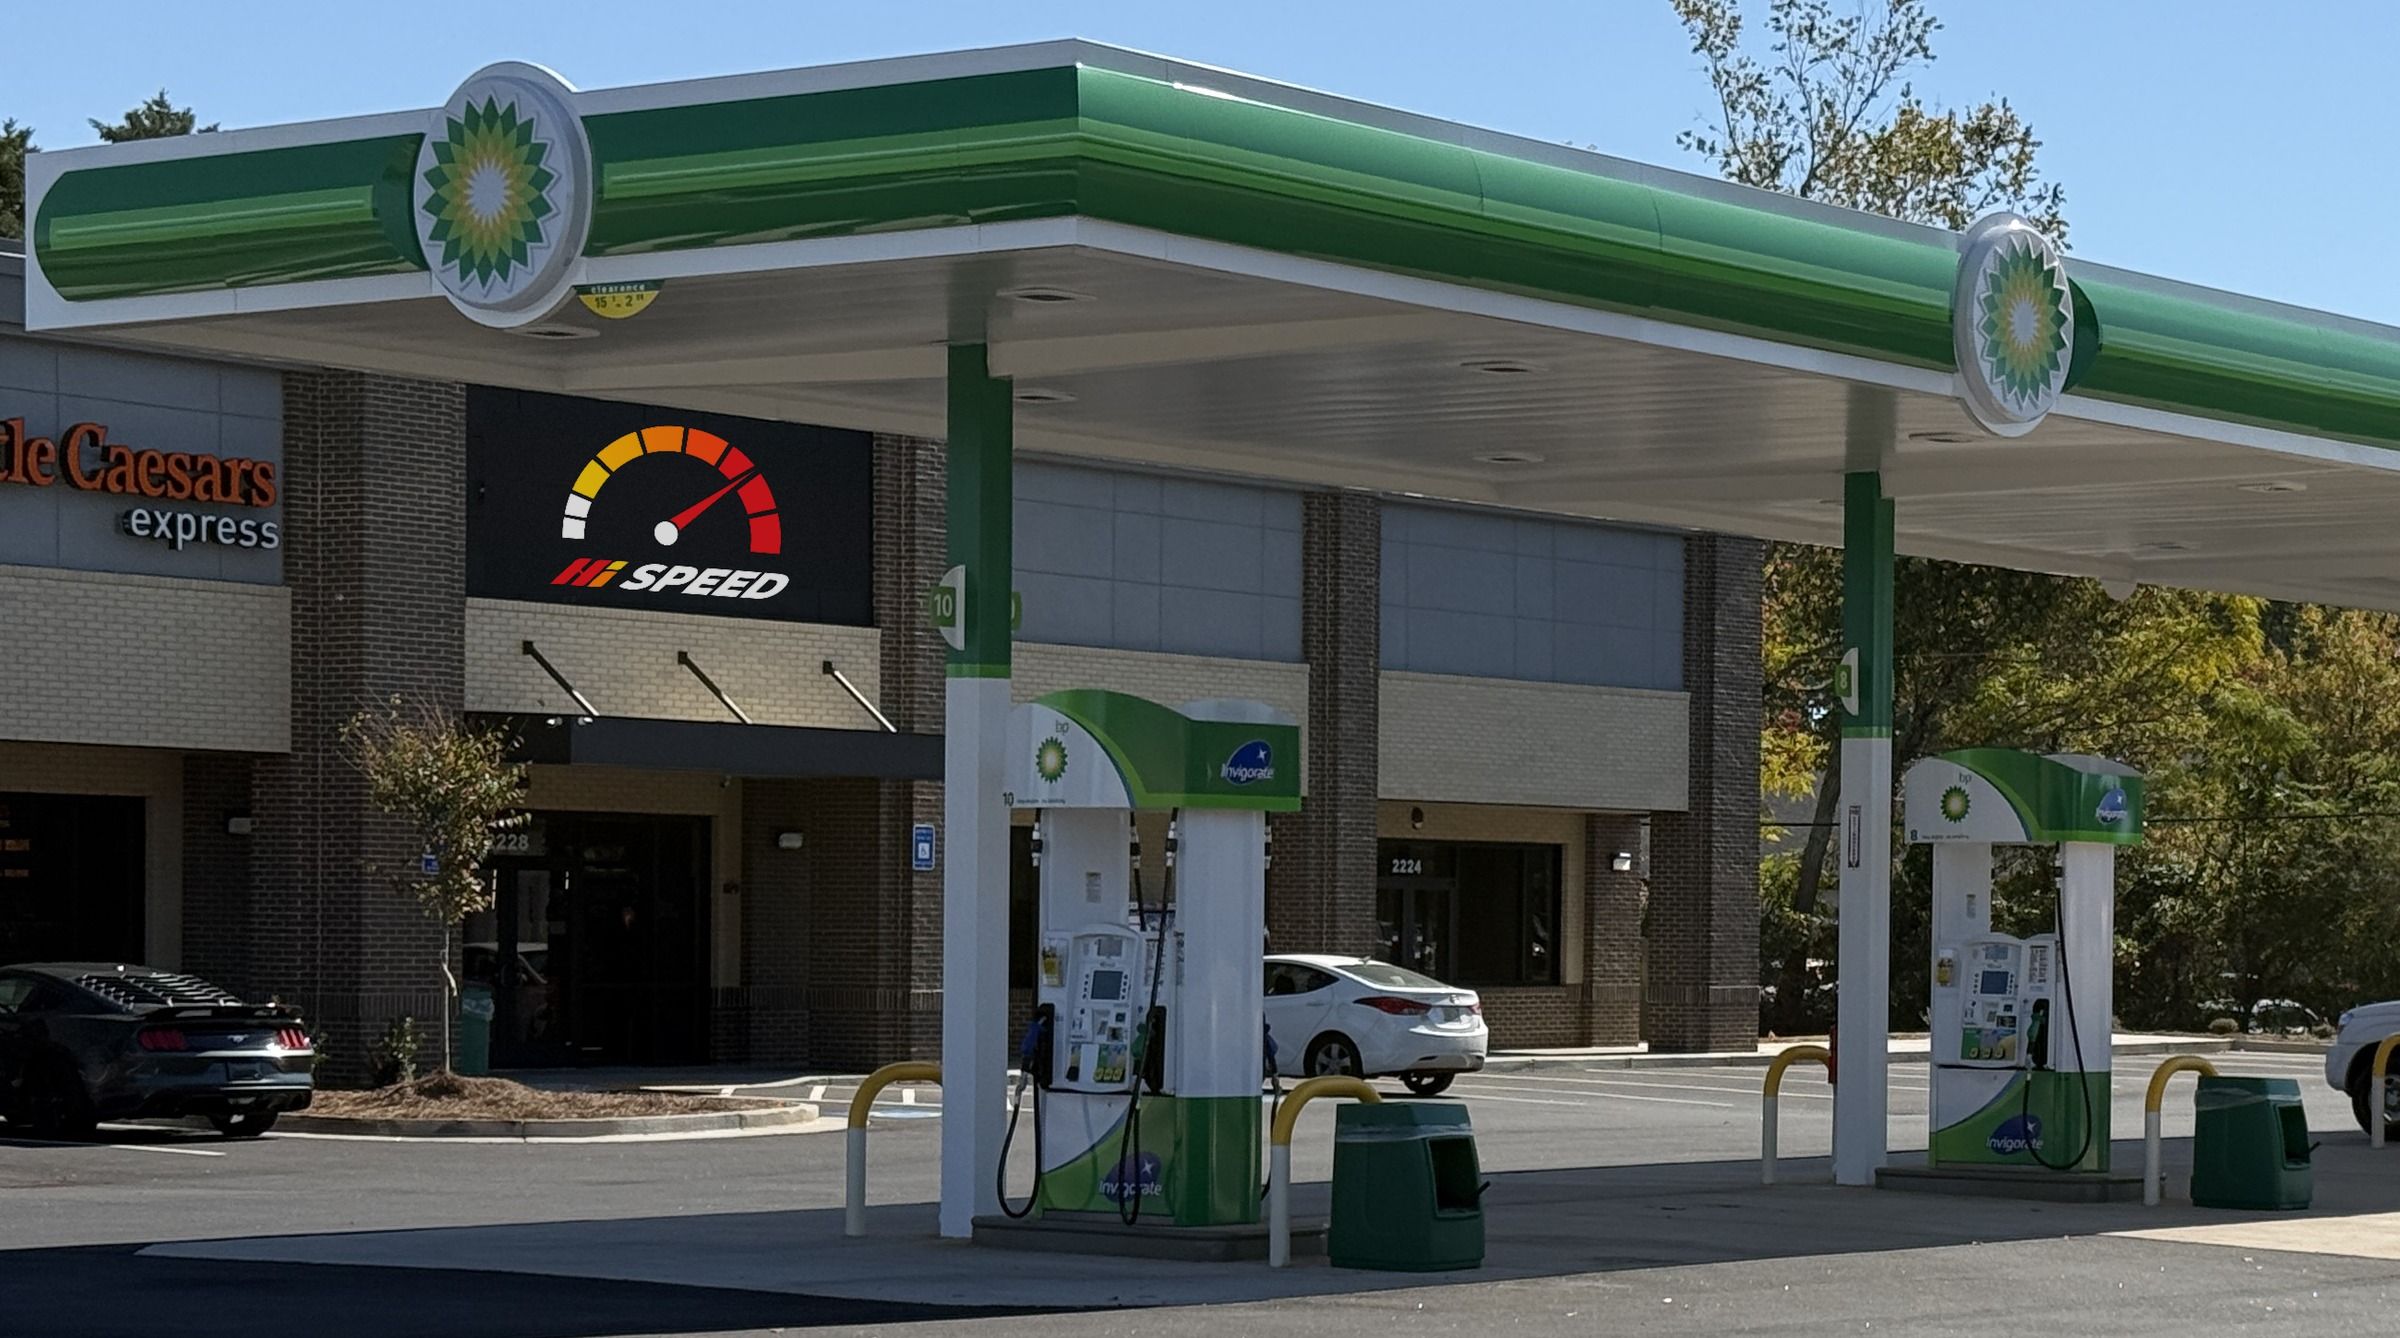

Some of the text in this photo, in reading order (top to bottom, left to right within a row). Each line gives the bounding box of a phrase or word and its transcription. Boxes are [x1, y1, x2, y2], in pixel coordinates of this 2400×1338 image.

[62, 422, 277, 507] Caesars
[130, 508, 280, 550] express
[550, 557, 790, 600] Hi SPEED
[934, 593, 953, 617] 10
[1840, 671, 1848, 689] 8
[1055, 720, 1069, 736] bp
[1002, 792, 1014, 807] 10
[1391, 858, 1422, 874] 2224
[1985, 1135, 2044, 1153] Invigorte
